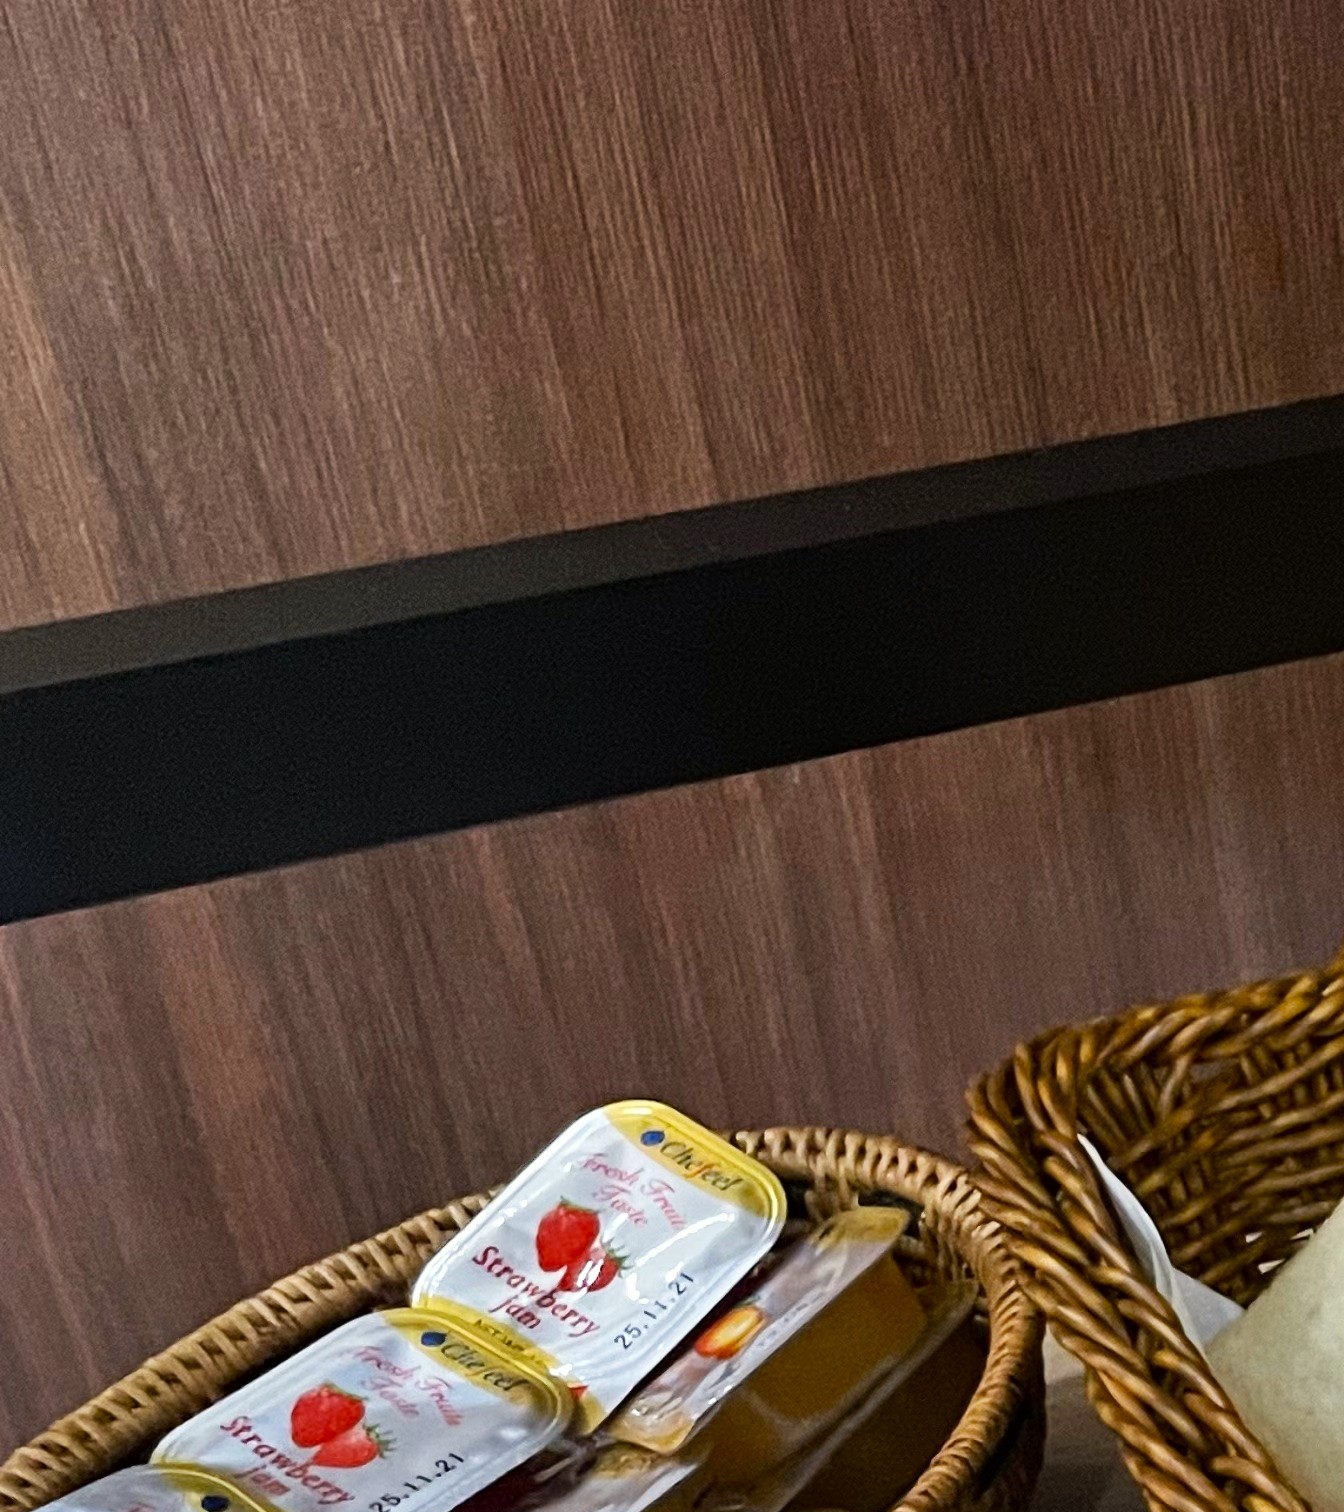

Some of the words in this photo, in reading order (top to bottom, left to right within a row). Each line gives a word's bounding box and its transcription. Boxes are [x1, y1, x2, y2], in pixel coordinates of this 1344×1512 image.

[472, 1246, 601, 1338] Strawberry
[614, 1272, 695, 1350] 25.11.21
[219, 1414, 356, 1507] Strawberry
